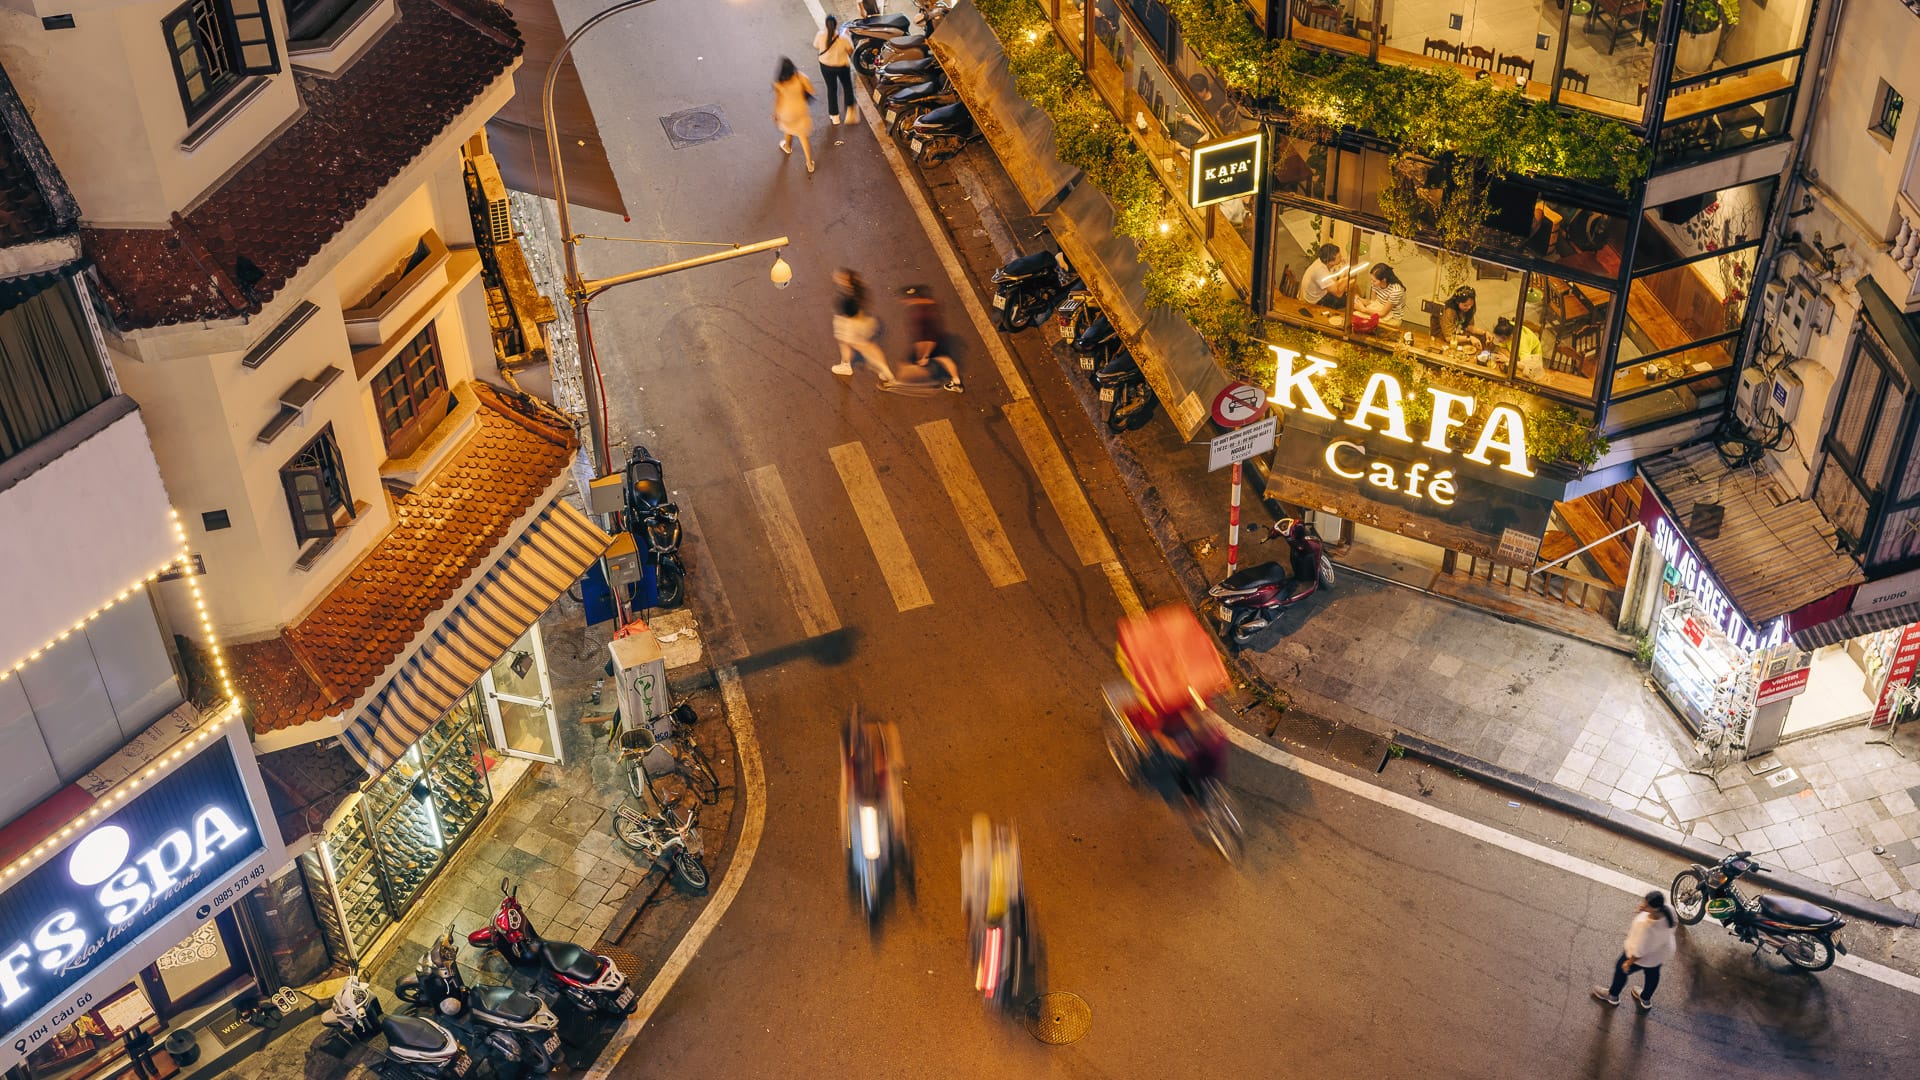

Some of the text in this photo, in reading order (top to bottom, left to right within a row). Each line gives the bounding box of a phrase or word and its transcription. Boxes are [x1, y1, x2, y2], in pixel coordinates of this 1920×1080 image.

[1266, 344, 1535, 477] KAFA
[1325, 441, 1457, 505] Café
[1654, 517, 1679, 567] SIM
[1678, 551, 1697, 590] 4G
[1695, 570, 1728, 627] FREE
[1872, 590, 1907, 604] STUDIO
[214, 864, 265, 907] 0985 578 483
[29, 1024, 49, 1043] 104
